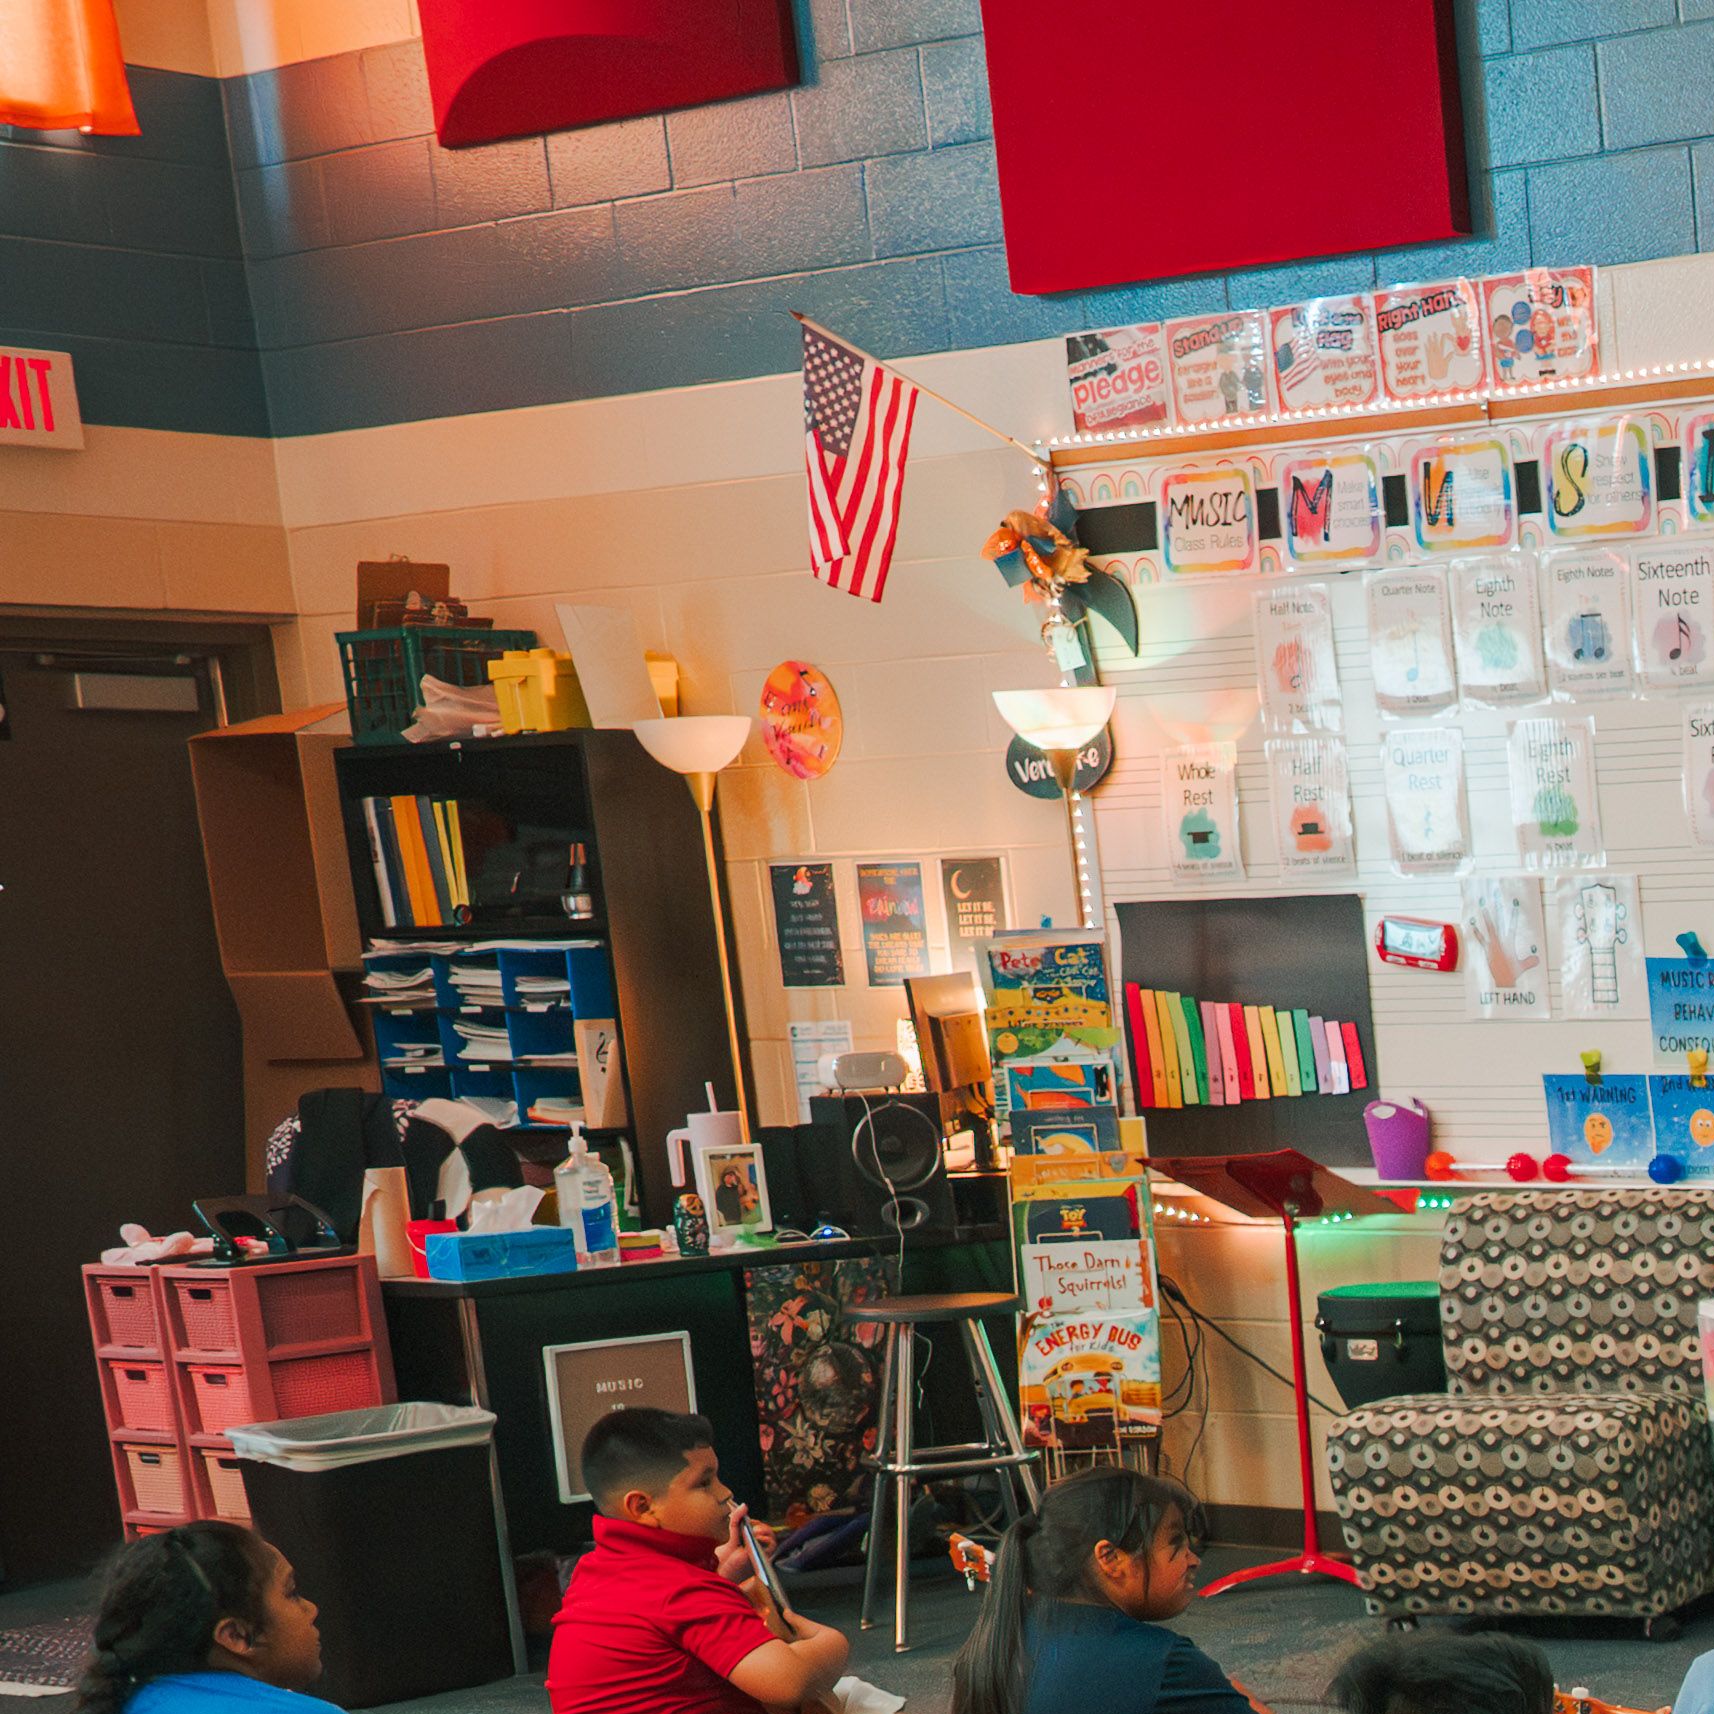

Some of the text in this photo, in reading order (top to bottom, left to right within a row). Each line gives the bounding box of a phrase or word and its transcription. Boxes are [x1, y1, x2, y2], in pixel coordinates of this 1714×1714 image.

[1377, 303, 1421, 333] Right
[1173, 326, 1220, 358] Stand
[1553, 442, 1590, 518] S
[1168, 490, 1249, 531] MUSIC
[1291, 468, 1334, 543] M
[1336, 499, 1366, 514] smart
[1174, 533, 1245, 553] Class Rules
[1556, 564, 1616, 584] Eighth Notes
[1637, 556, 1712, 583] Sixteenth
[1381, 582, 1437, 598] Quarter Note
[1474, 575, 1516, 598] Eighth
[1658, 587, 1701, 608] Note
[1269, 600, 1292, 617] Half
[1480, 601, 1513, 618] Note
[1678, 665, 1699, 677] beat
[1391, 746, 1450, 767] Quarter
[1528, 736, 1575, 762] Eighth
[1014, 747, 1101, 784] Verre
[1177, 761, 1217, 781] Whole
[1292, 756, 1322, 777] Half
[1536, 766, 1571, 785] Rest
[1407, 773, 1443, 791] Rest
[1183, 789, 1214, 806] Rest
[1293, 784, 1324, 803] Rest
[1000, 947, 1089, 970] Pete Cat
[1660, 971, 1705, 989] MUSIC
[1480, 991, 1536, 1005] LEFT HAND
[1661, 1075, 1685, 1094] 2nd
[1579, 1086, 1637, 1105] WARNING
[1059, 1207, 1087, 1222] TOY
[1033, 1251, 1121, 1272] Those Darn
[1058, 1274, 1128, 1297] Squirrels!
[1034, 1322, 1143, 1357] ENERGY BUS
[1070, 1341, 1116, 1352] for Kids
